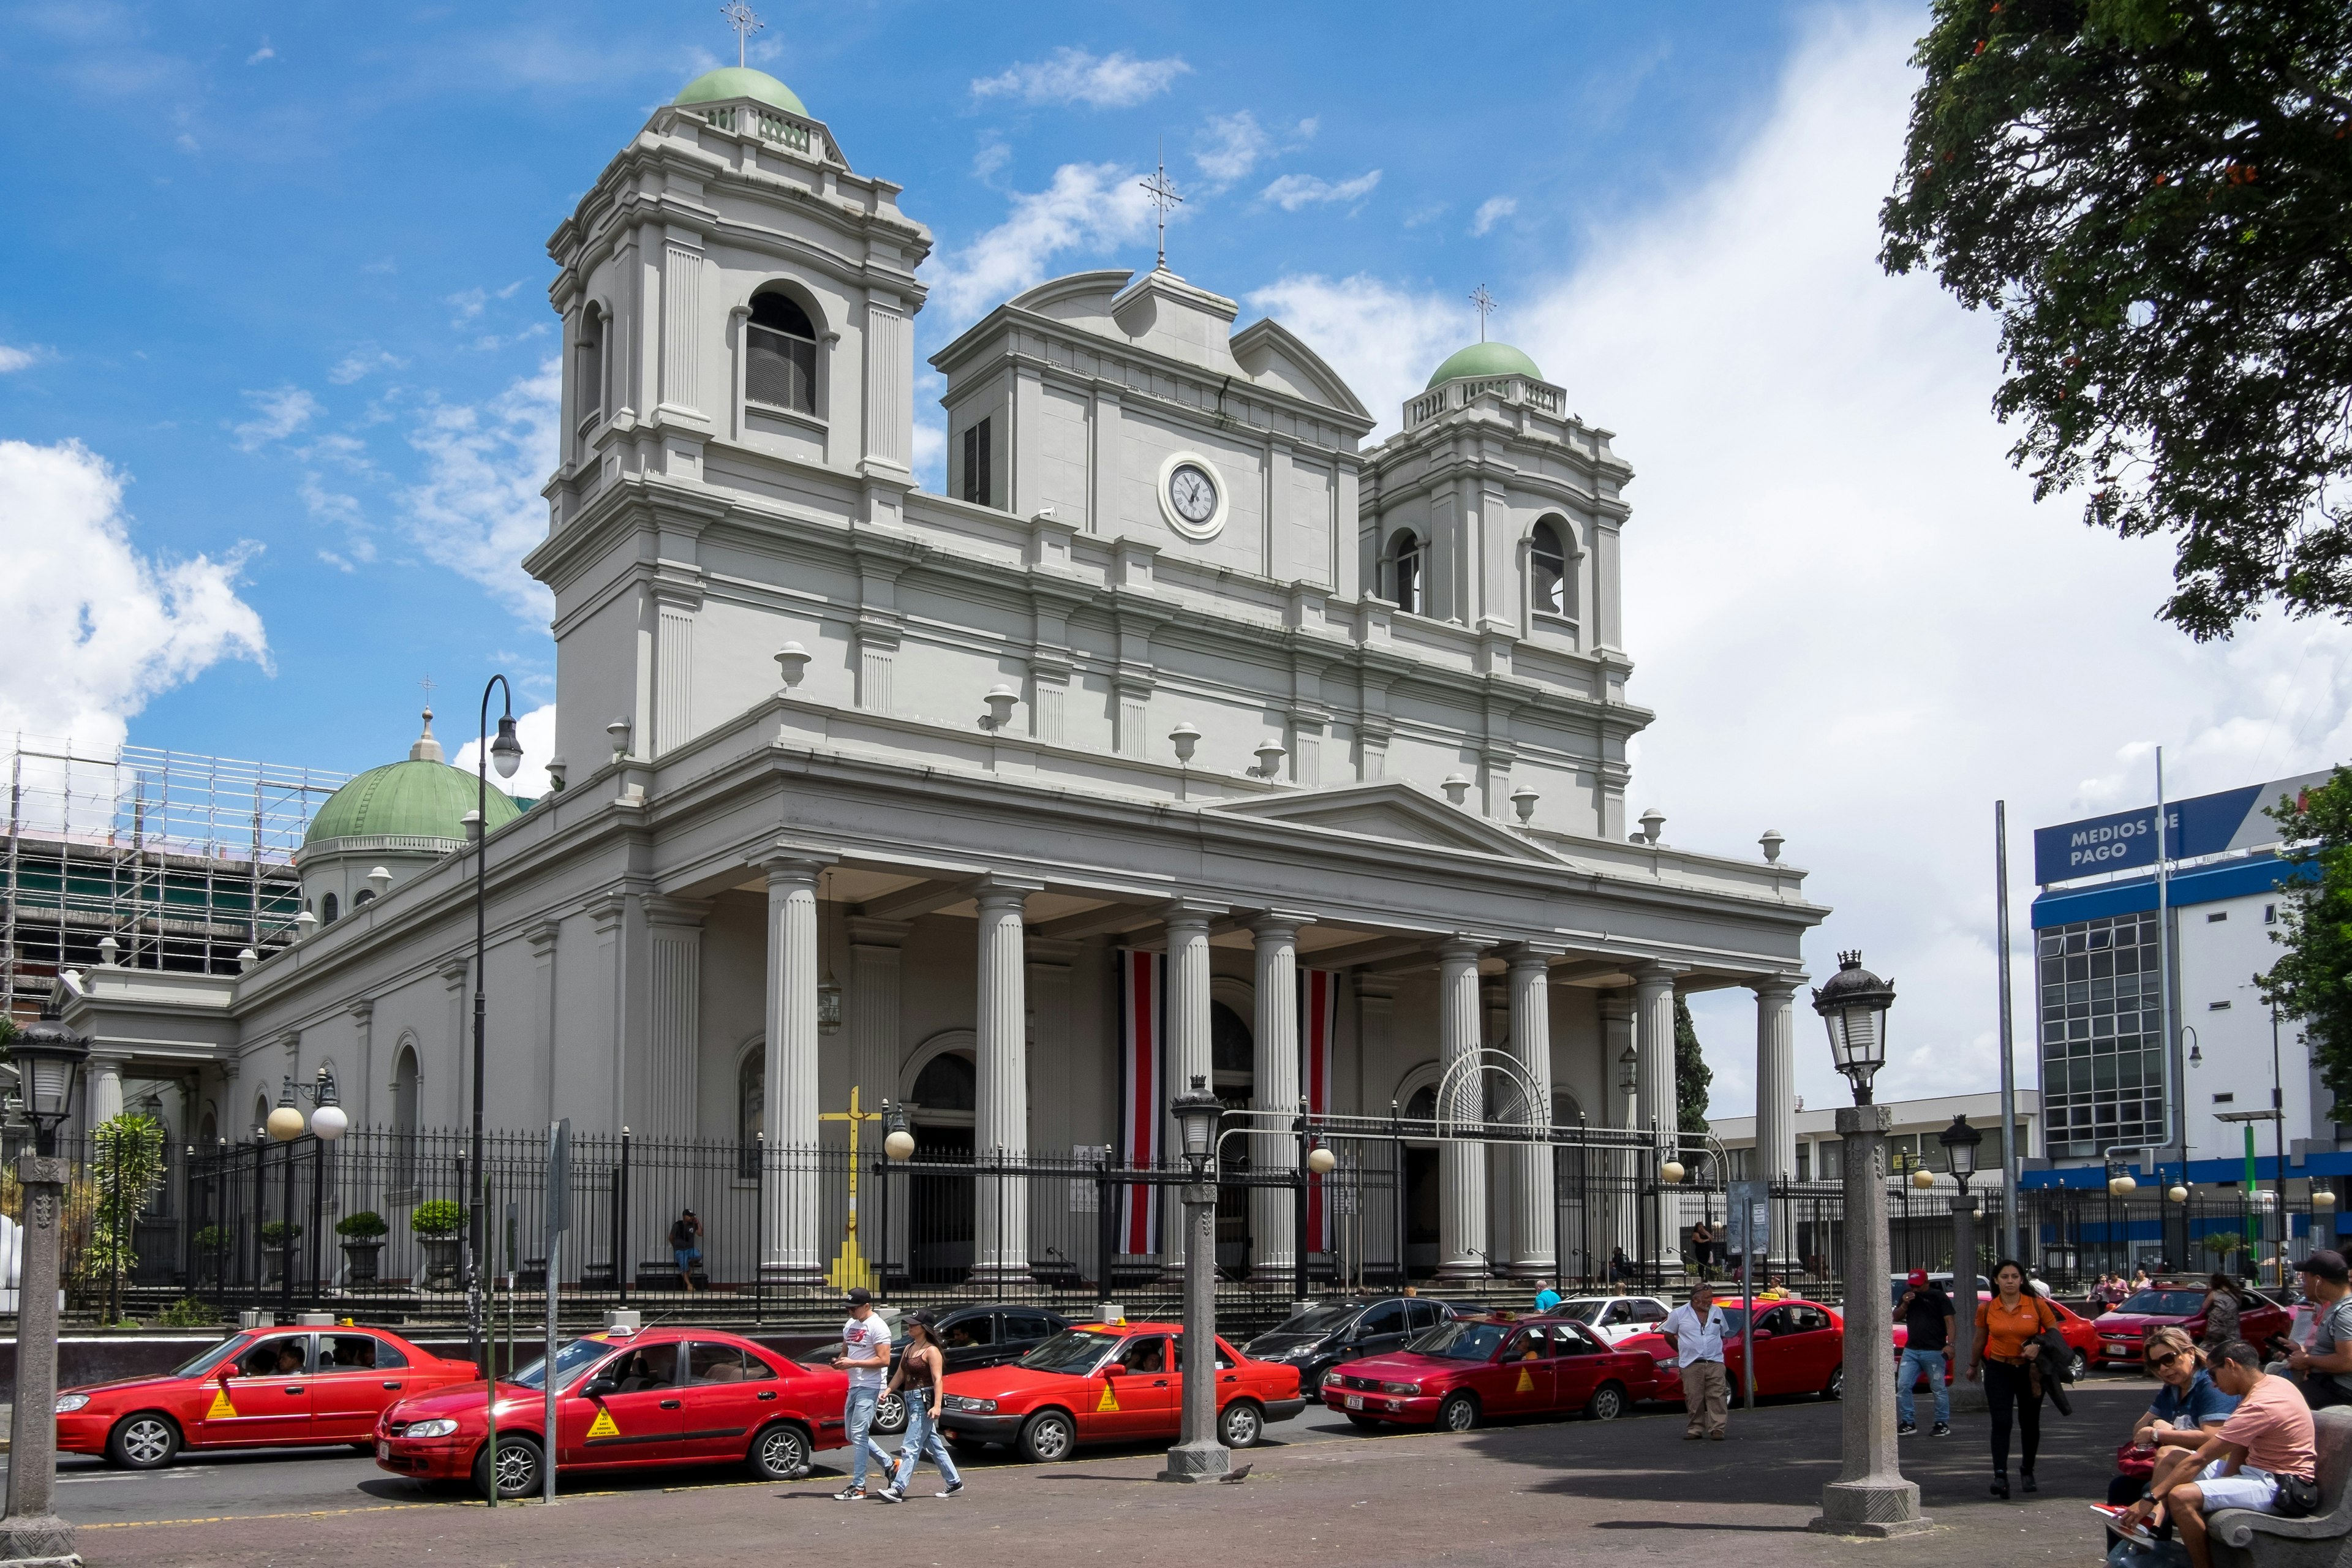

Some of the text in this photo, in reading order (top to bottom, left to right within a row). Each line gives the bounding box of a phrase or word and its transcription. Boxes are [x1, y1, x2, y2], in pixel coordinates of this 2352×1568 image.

[2071, 813, 2179, 848] MEDIOS DE
[2071, 842, 2127, 866] PAGO
